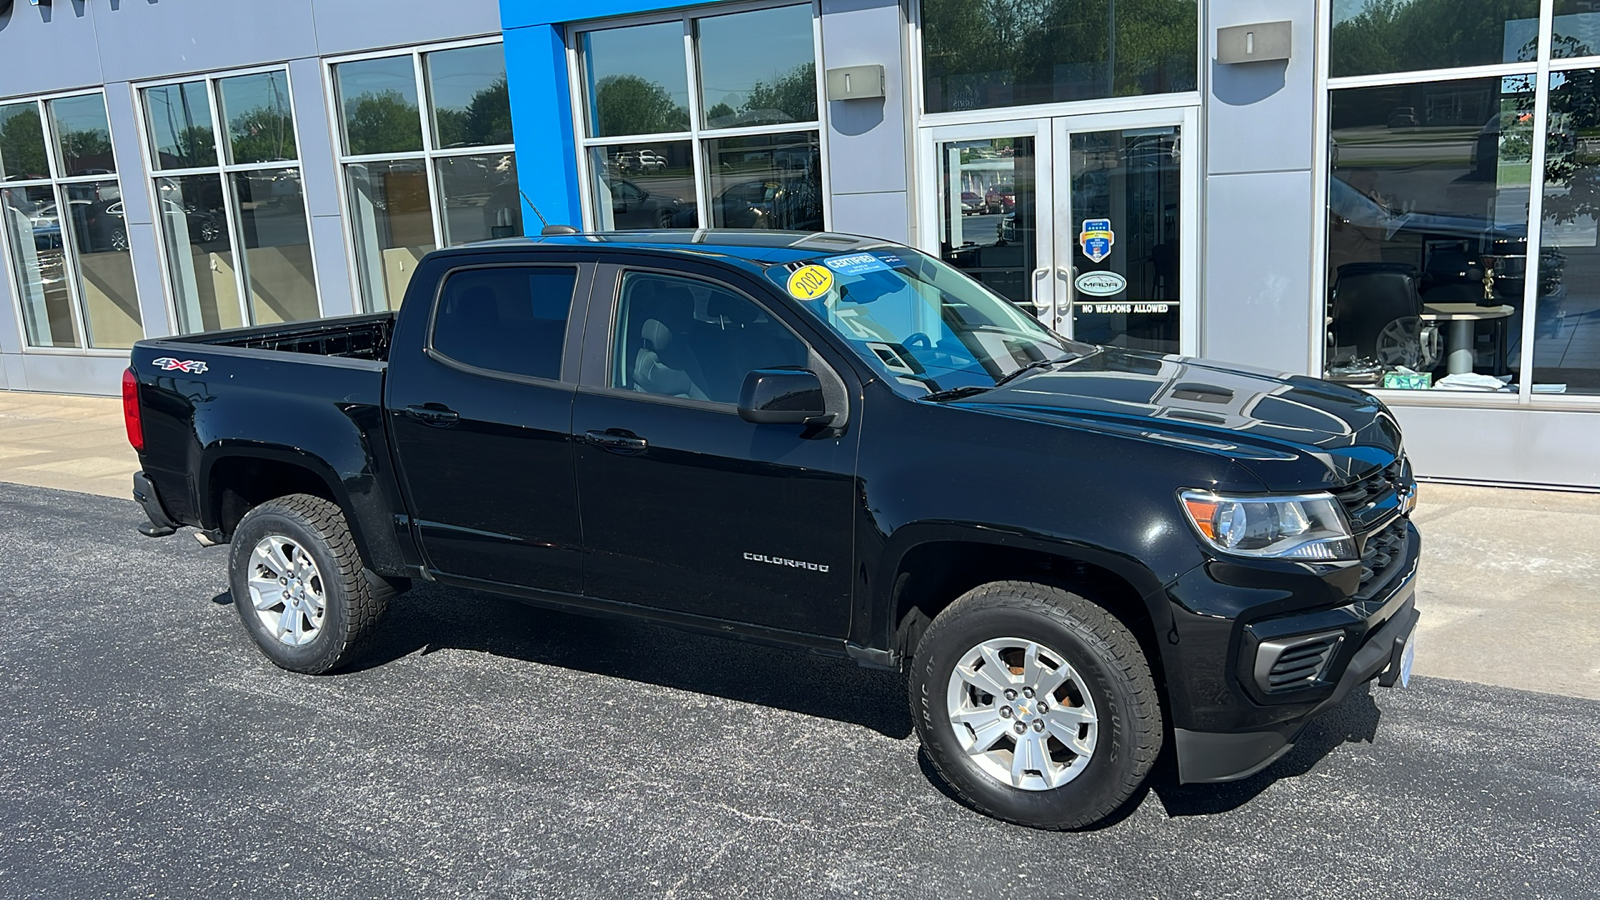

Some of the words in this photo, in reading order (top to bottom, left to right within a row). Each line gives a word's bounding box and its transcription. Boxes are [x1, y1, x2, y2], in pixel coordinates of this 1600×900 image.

[827, 254, 876, 269] CERTIFIED
[795, 267, 828, 296] 2021
[1082, 304, 1093, 313] NO
[1096, 304, 1131, 313] WEAPONS
[1134, 304, 1168, 313] ALLOWED
[743, 552, 829, 573] COLORADO
[921, 683, 934, 731] TRAC
